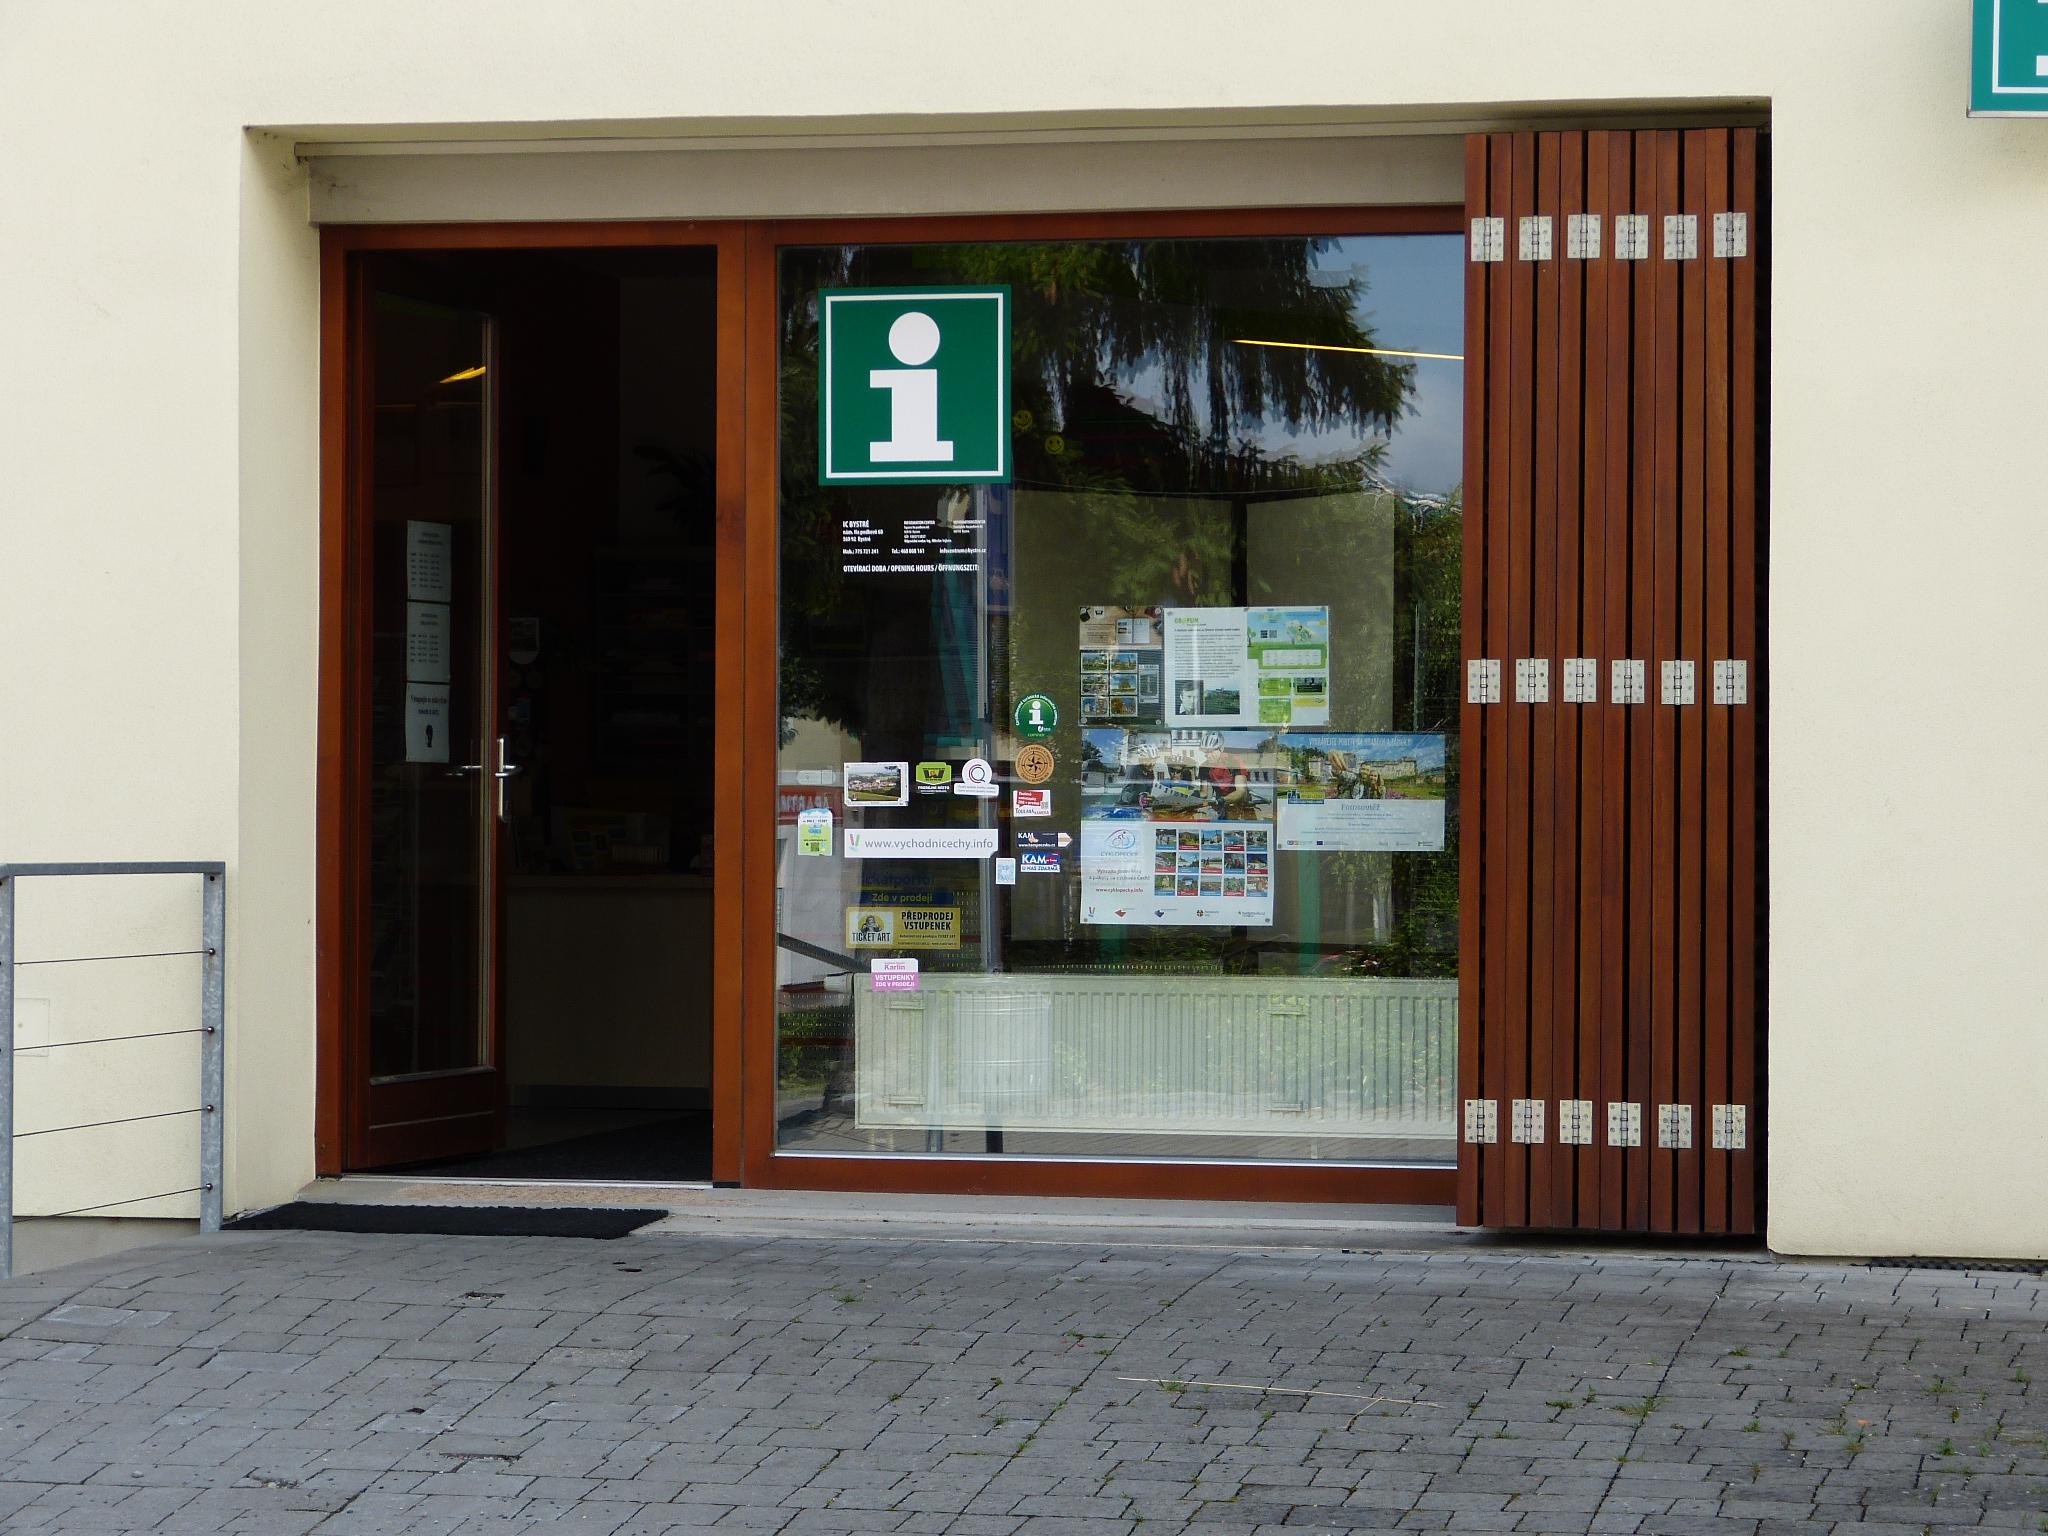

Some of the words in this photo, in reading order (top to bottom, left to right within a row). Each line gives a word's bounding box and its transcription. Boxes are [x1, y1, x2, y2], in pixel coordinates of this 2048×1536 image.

[843, 564, 871, 573] OTEVÍRACÍ
[871, 564, 887, 572] DOBA
[890, 564, 915, 572] OPENING
[915, 564, 934, 572] HOURS
[865, 838, 994, 851] www.vychodnicechy.info
[1022, 854, 1047, 864] KAM
[872, 893, 889, 902] Zde
[900, 893, 933, 904] prodeji
[901, 910, 954, 921] PŘEDPRODEJ
[903, 921, 951, 930] VSTUPENEK
[852, 932, 876, 942] TICKET
[877, 932, 891, 942] ART
